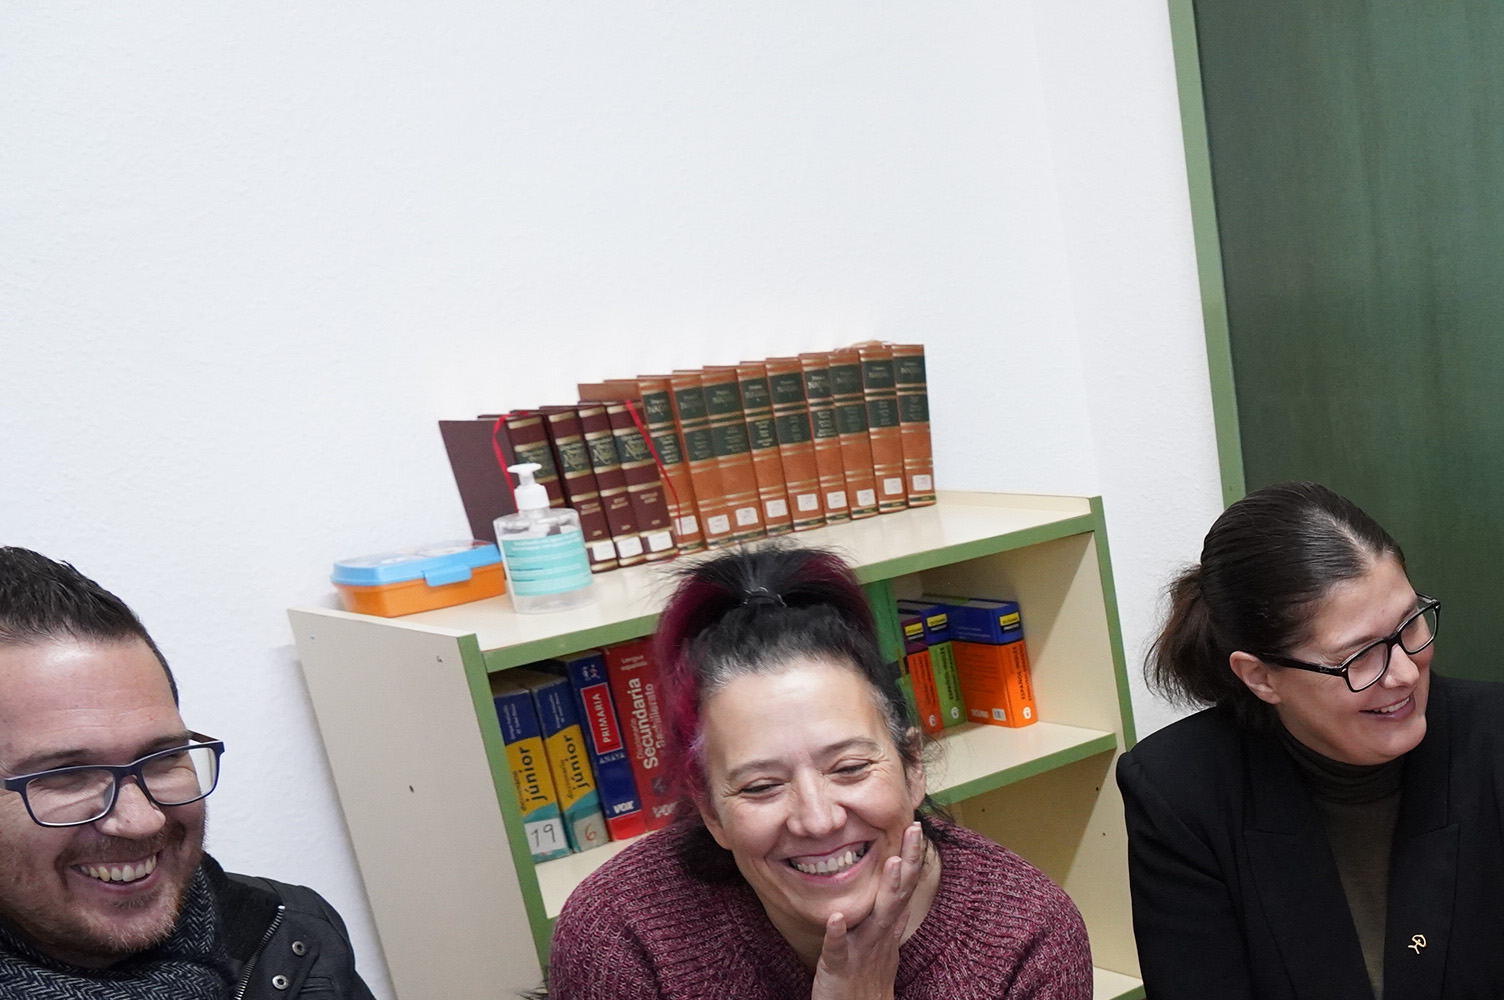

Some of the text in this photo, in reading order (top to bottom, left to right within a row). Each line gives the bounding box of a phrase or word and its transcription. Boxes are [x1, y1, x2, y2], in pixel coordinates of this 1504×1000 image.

[592, 693, 611, 743] PRIMARIA
[627, 678, 659, 769] Secundaria
[519, 747, 548, 802] júnior
[564, 734, 590, 790] júnior
[599, 752, 625, 764] ANAYA
[613, 800, 635, 814] VOX
[531, 823, 556, 848] 19
[584, 823, 597, 842] 6
